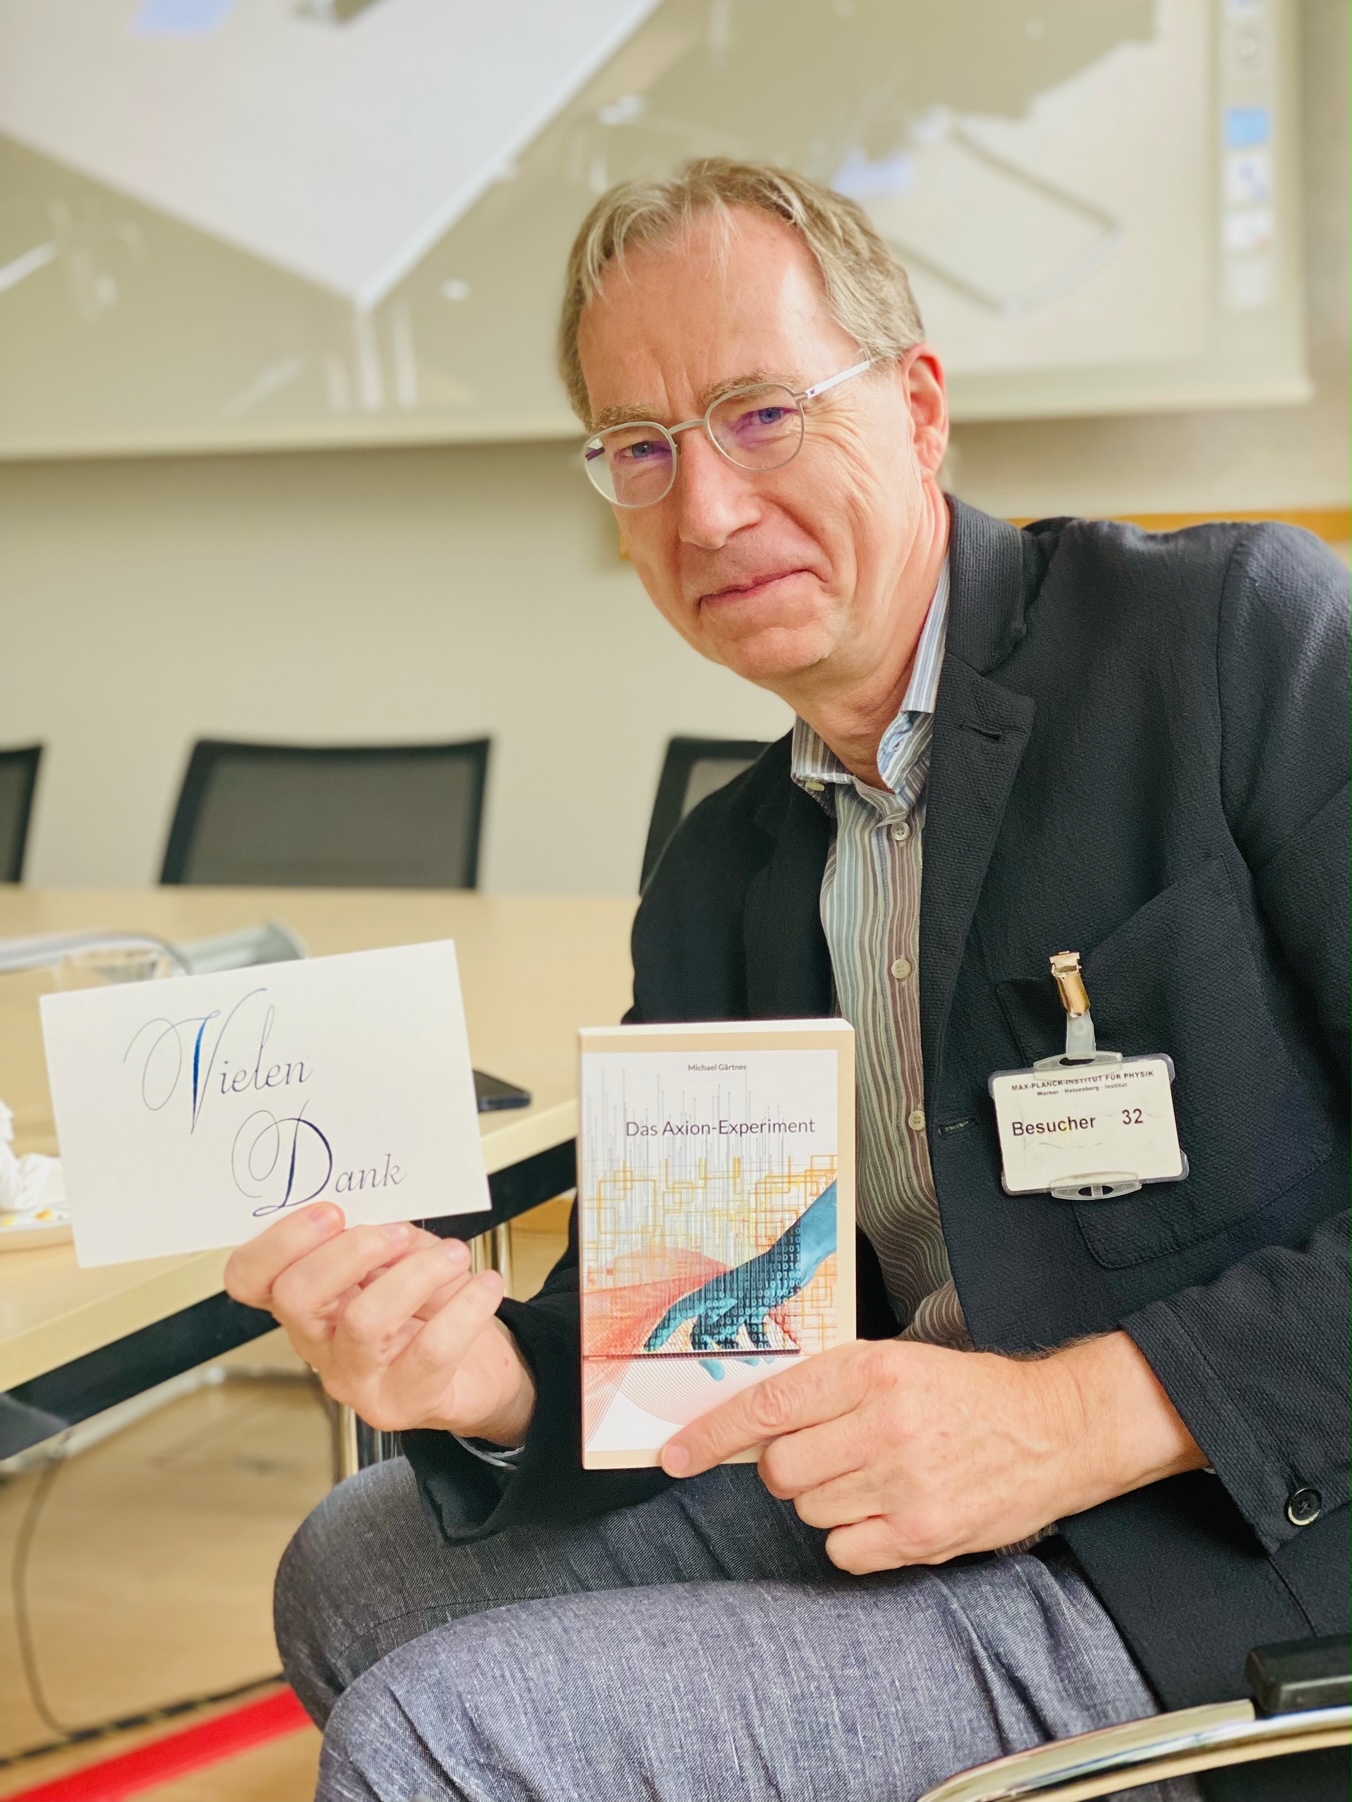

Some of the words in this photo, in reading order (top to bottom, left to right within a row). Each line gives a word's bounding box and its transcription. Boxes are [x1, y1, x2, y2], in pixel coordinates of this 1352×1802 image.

[123, 988, 313, 1134] Vielen
[688, 1063, 717, 1072] Michael
[718, 1063, 748, 1072] Gärtner
[1011, 1075, 1103, 1091] MAX-PLANCK-INSTITUT
[1123, 1070, 1154, 1079] PHYSIK
[1064, 1085, 1100, 1094] Heisenberg
[626, 1121, 658, 1137] Das
[662, 1118, 816, 1137] Axion-Experiment
[1011, 1115, 1096, 1137] Besucher
[1121, 1108, 1144, 1125] 32
[232, 1100, 406, 1217] Dank
